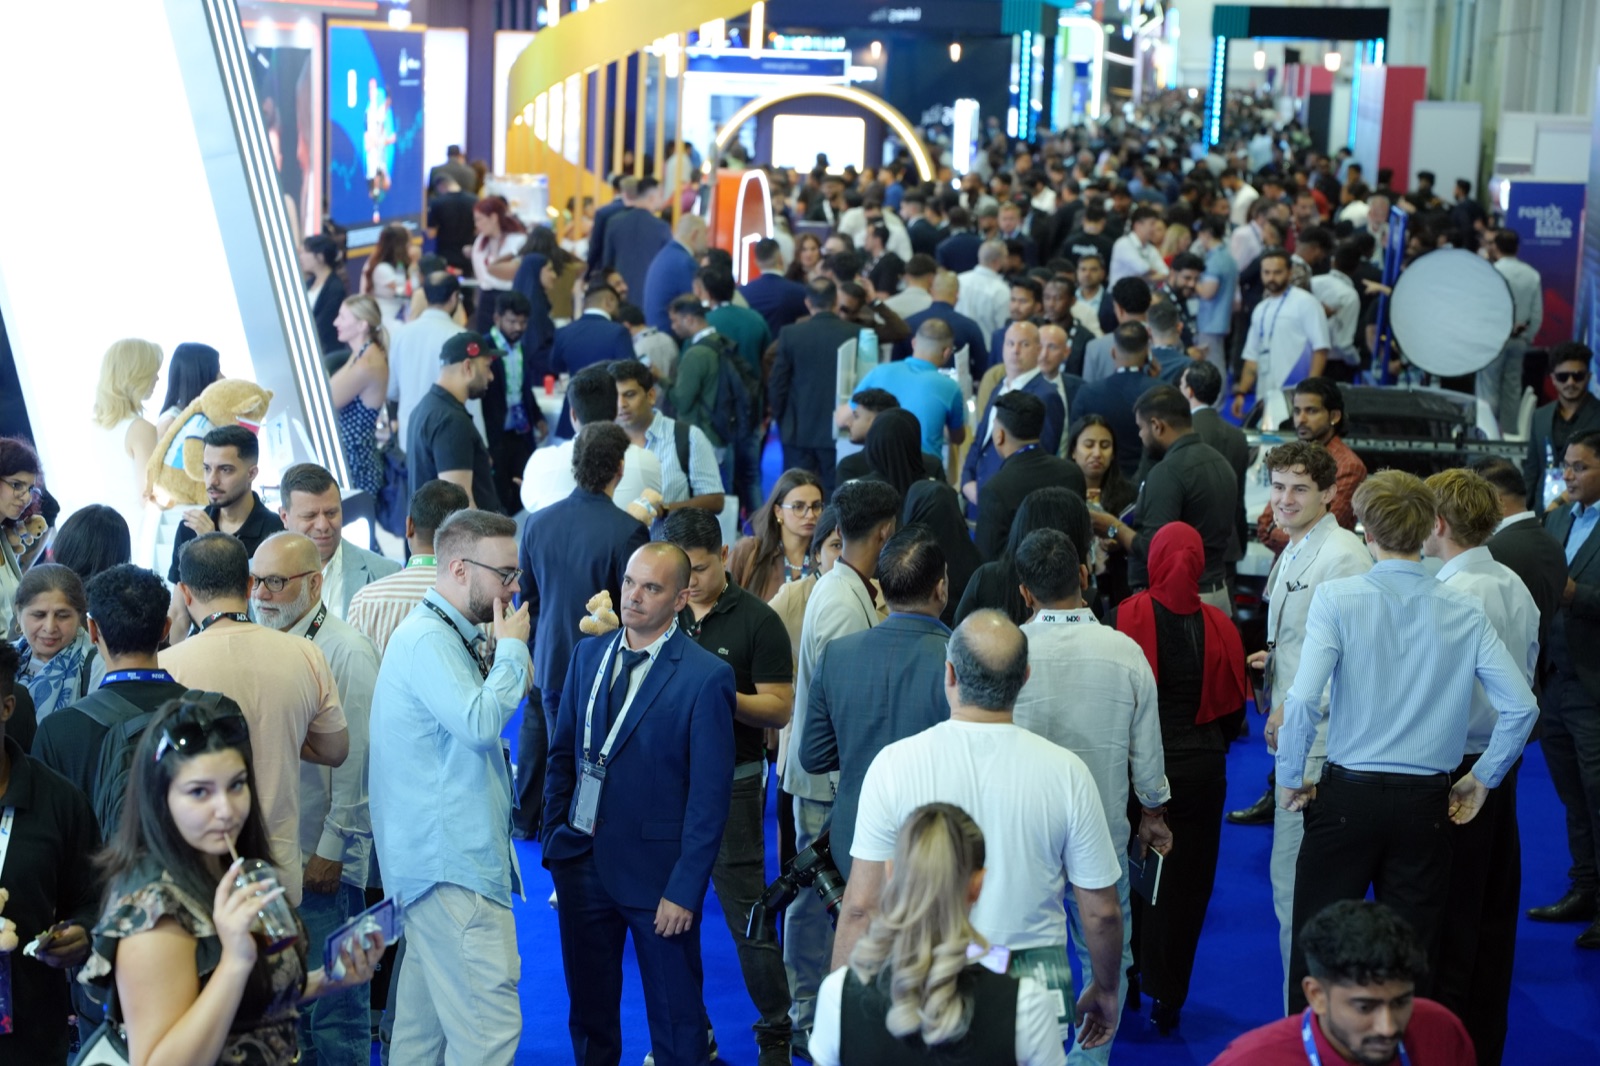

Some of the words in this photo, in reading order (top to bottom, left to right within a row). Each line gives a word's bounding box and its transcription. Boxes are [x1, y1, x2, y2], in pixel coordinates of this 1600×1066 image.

[1518, 205, 1562, 219] FOREX
[1041, 614, 1056, 623] XM
[1066, 614, 1081, 623] XM
